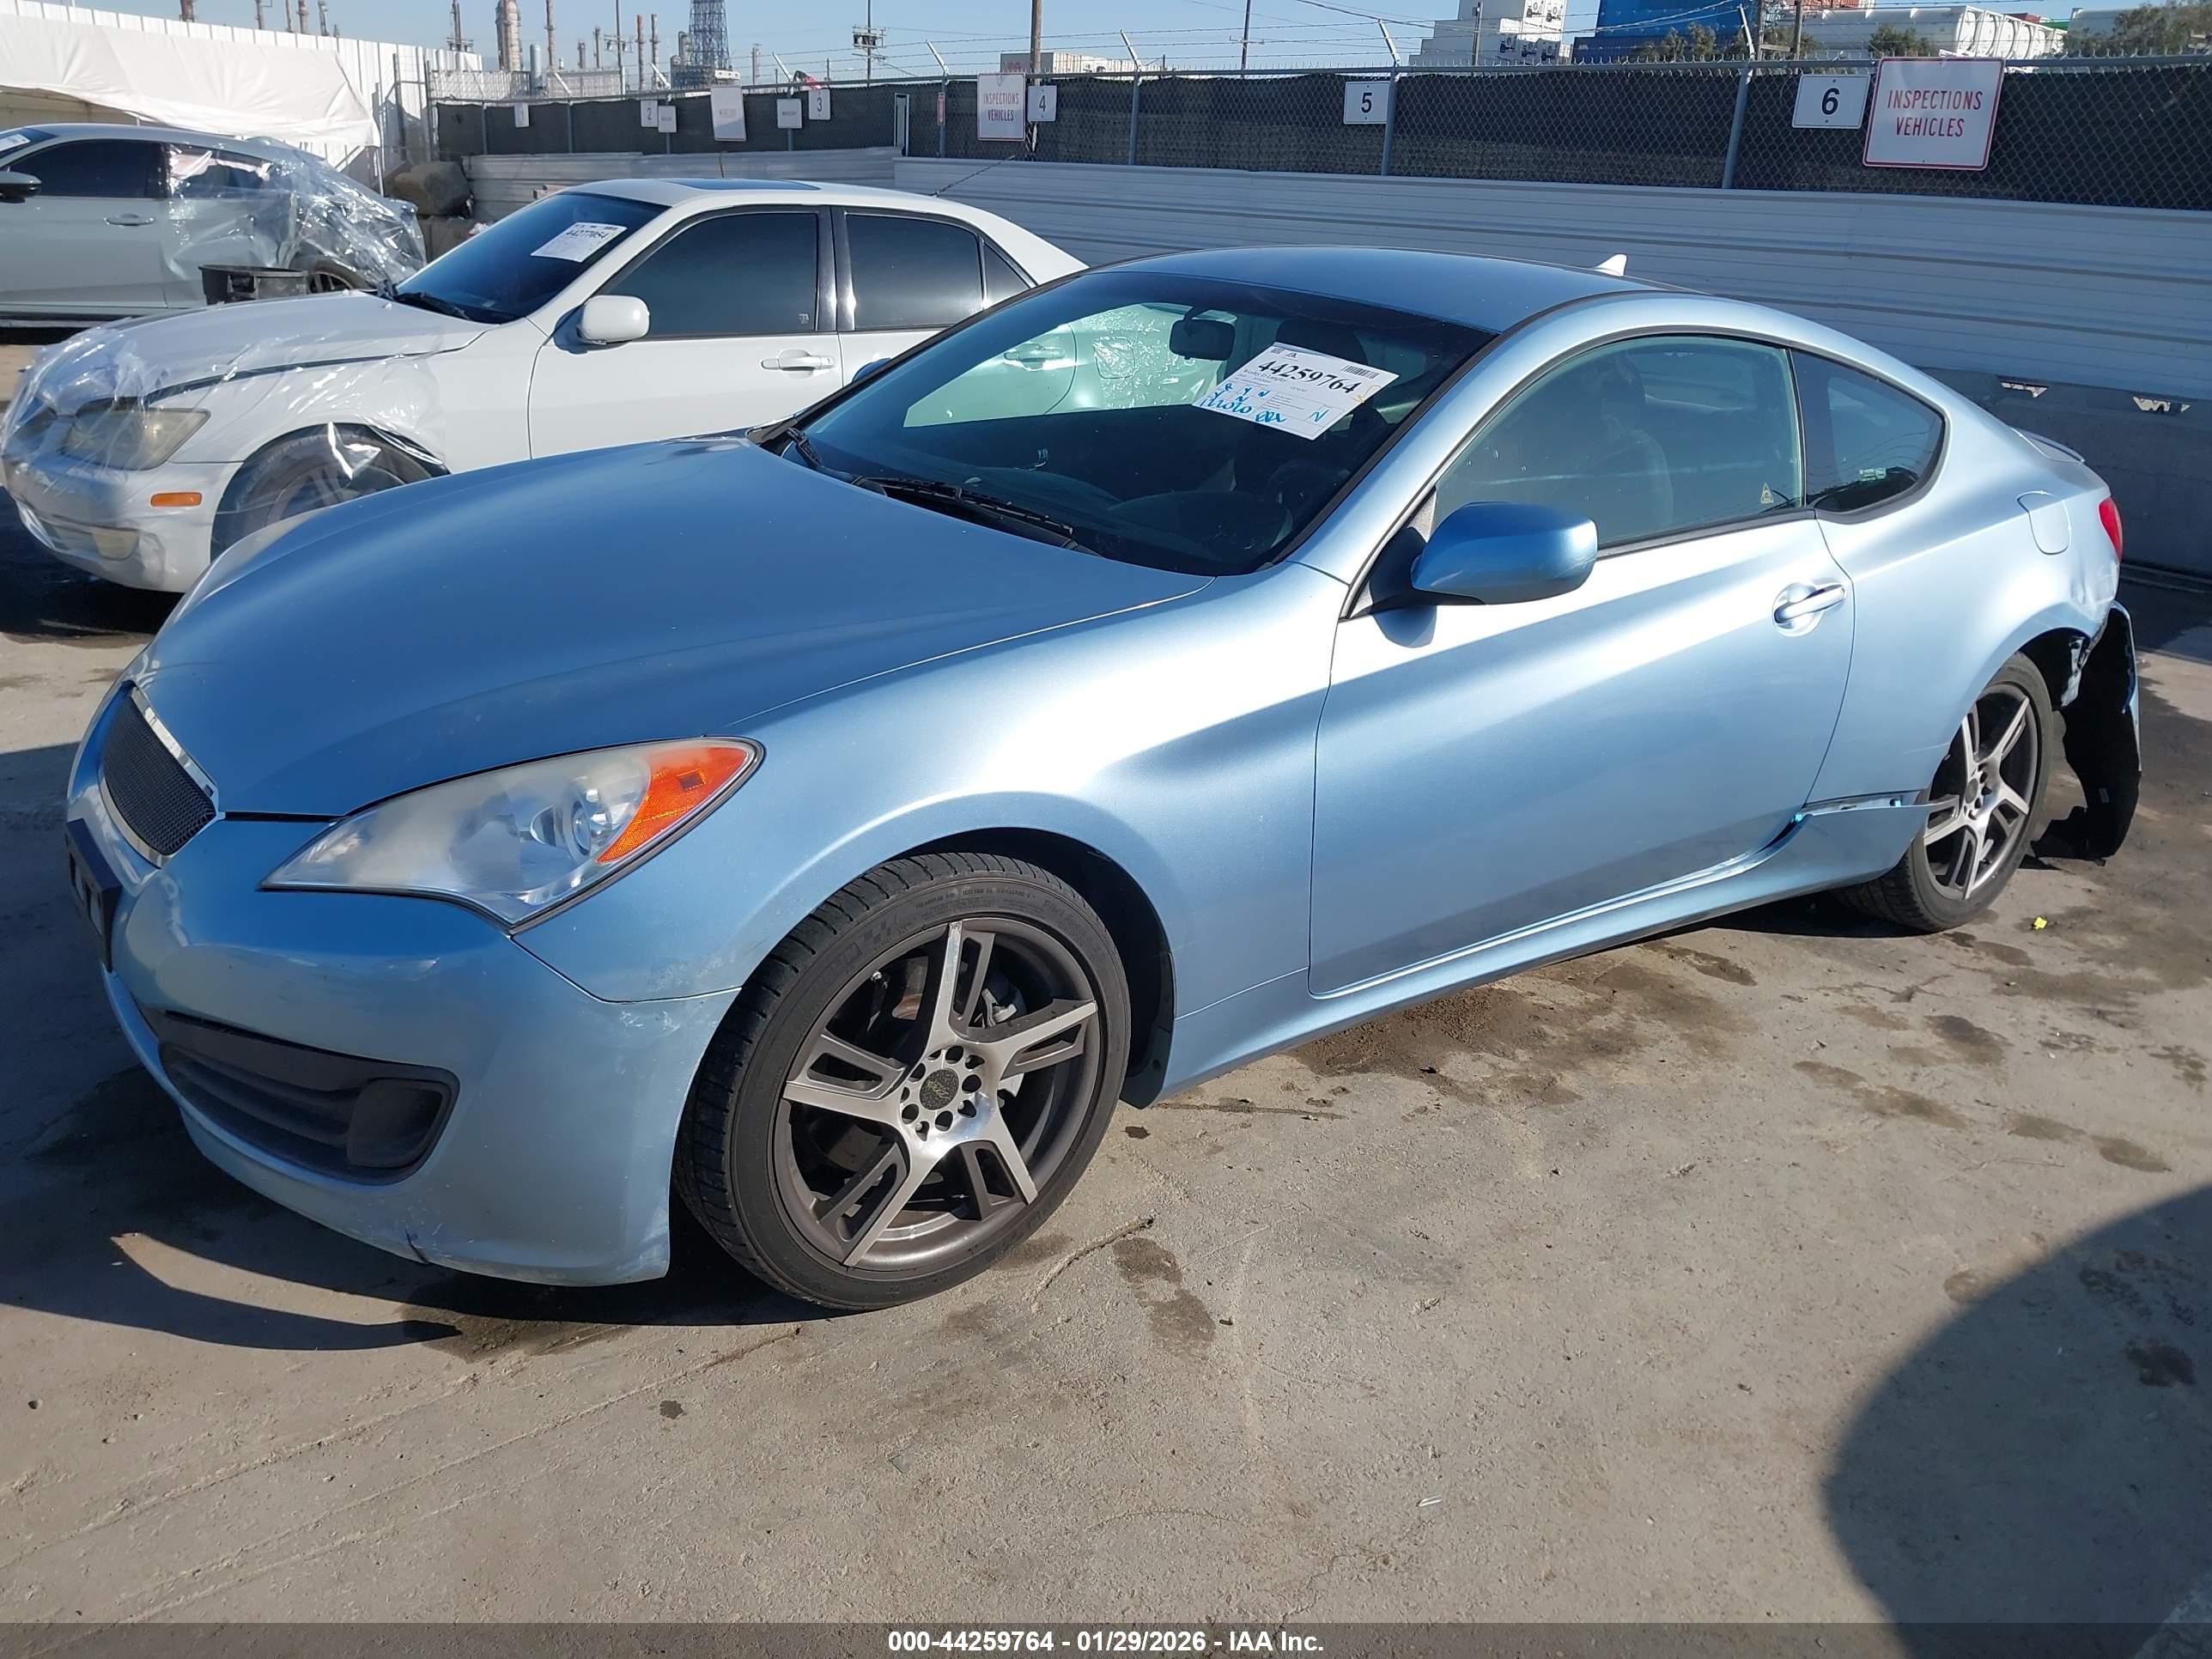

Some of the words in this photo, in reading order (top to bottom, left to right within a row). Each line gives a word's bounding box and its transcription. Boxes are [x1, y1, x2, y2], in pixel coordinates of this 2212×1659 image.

[817, 97, 823, 112] 3
[983, 92, 1019, 105] INSPECTIONS
[1038, 94, 1047, 112] 4
[1361, 92, 1372, 113] 5
[1821, 88, 1840, 115] 6
[1887, 89, 1984, 111] INSPECTIONS
[646, 106, 653, 120] 2
[988, 109, 1014, 122] VEHICLES
[1895, 117, 1965, 137] VEHICLES
[1258, 360, 1363, 394] 44259764
